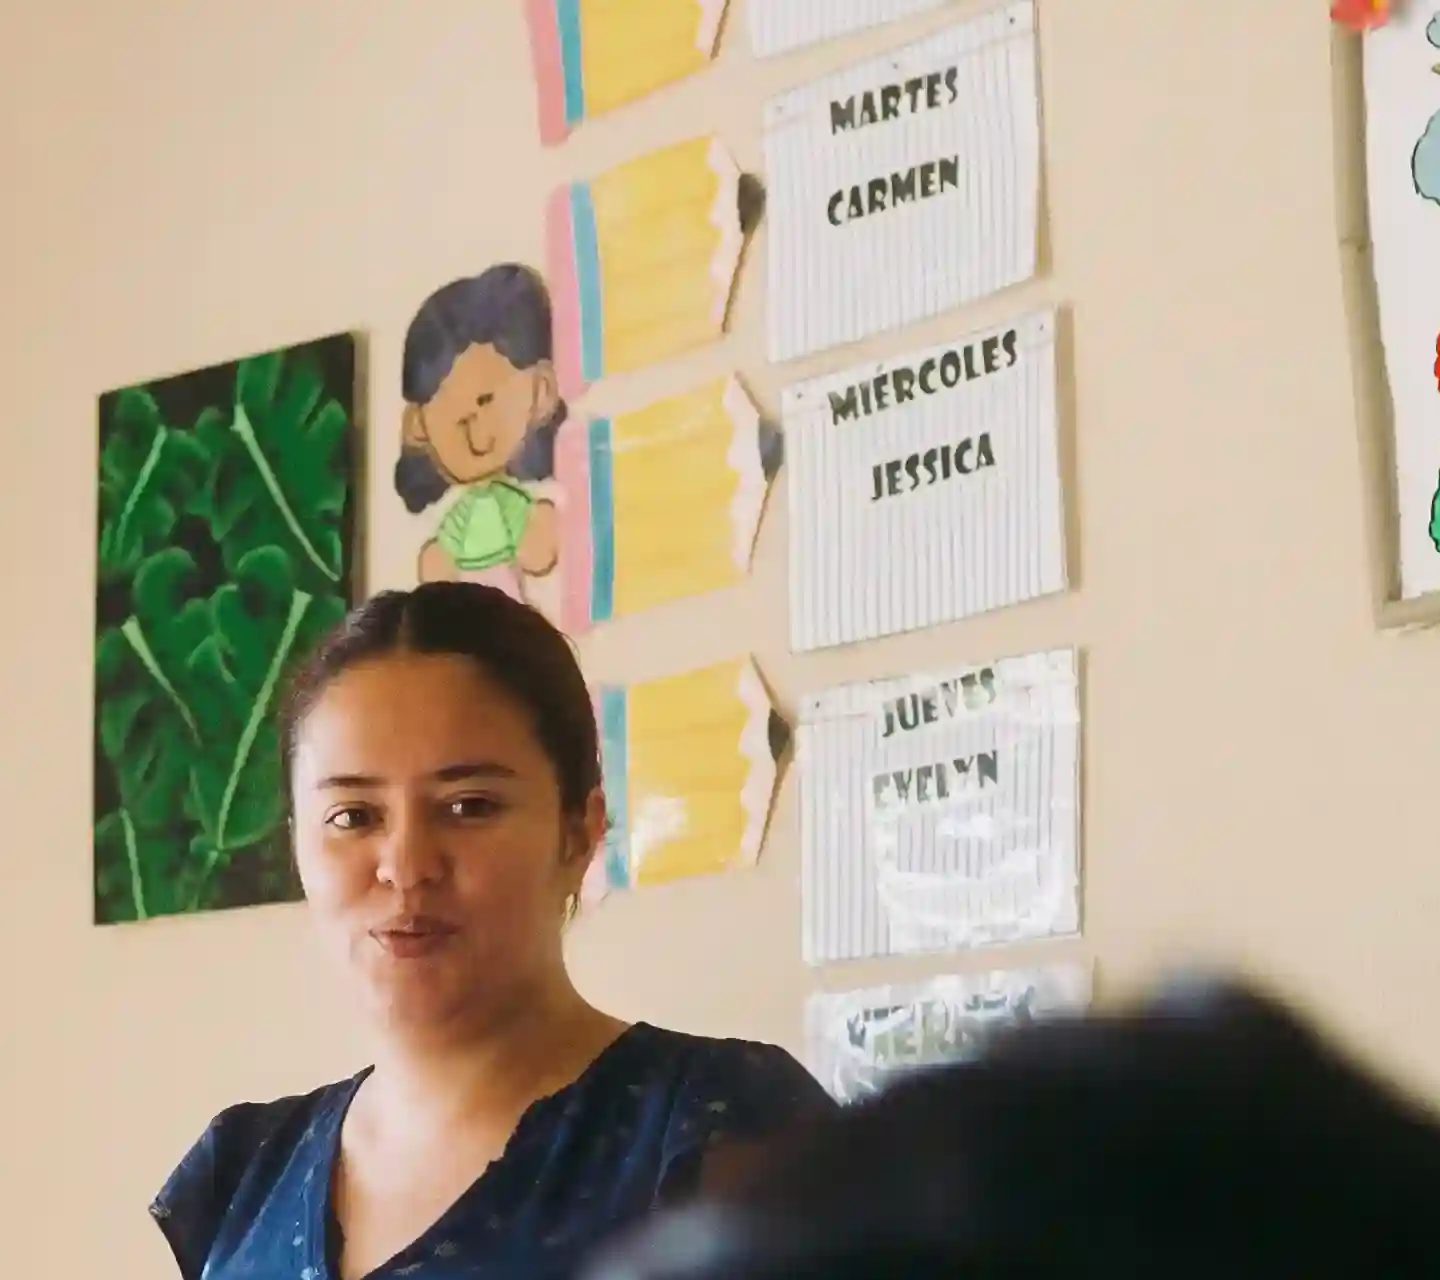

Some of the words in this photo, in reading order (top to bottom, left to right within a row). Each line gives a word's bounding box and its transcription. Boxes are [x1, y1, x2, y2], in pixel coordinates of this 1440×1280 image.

[829, 65, 959, 136] MARTES
[826, 154, 960, 228] CARMEN
[870, 432, 996, 502] JESSICA
